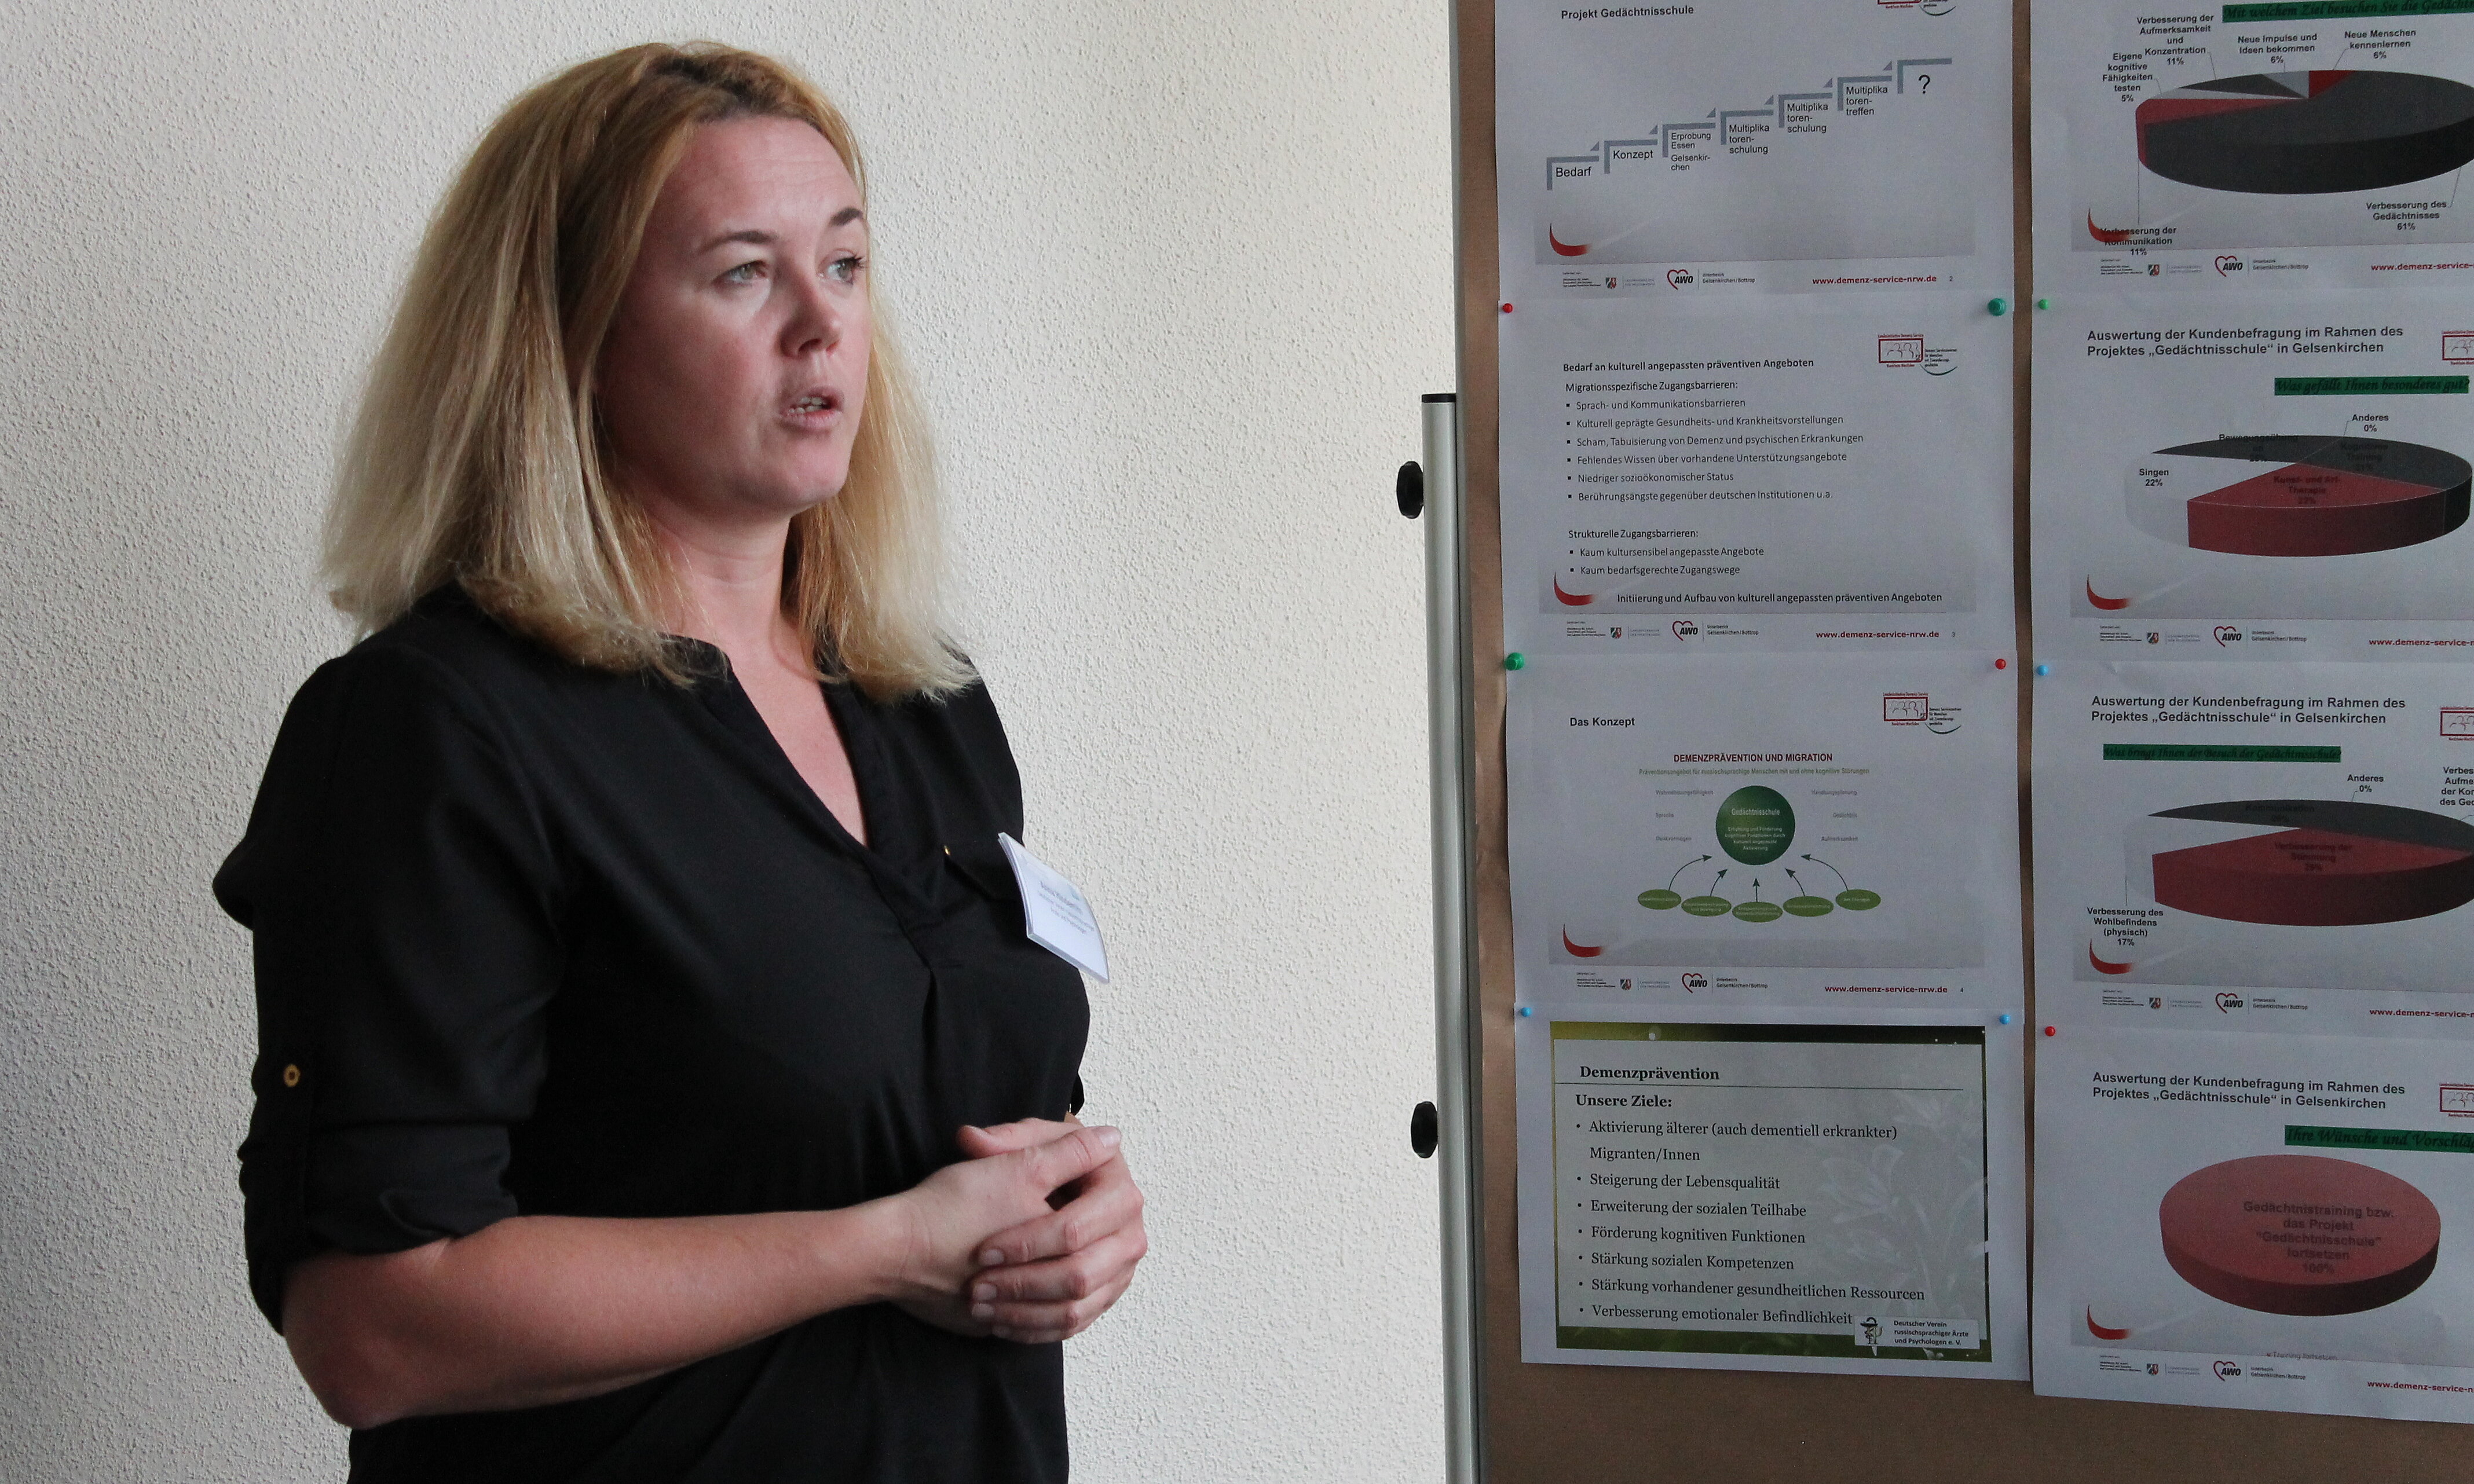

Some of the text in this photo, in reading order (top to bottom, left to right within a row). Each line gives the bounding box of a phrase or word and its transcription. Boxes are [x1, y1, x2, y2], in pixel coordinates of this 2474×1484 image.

[1562, 5, 1693, 21] Projekt Gedächtnisschule
[2140, 25, 2211, 35] Aufmerksamkeit
[2263, 35, 2297, 43] Impulse
[2350, 41, 2410, 49] kennenlernen
[2145, 47, 2205, 55] Konzentration
[2113, 53, 2142, 61] Eigene
[2108, 63, 2147, 72] kognitive
[2103, 74, 2153, 83] Fähigkeiten
[1919, 75, 1930, 94] ?
[1846, 86, 1887, 96] Multiplika
[1787, 103, 1828, 112] Multiplika
[1846, 107, 1874, 115] treffen
[1729, 124, 1769, 134] Multiplika
[1788, 124, 1827, 134] schulung
[1671, 132, 1711, 141] Erprobung
[1613, 150, 1653, 160] Konzept
[1730, 145, 1767, 155] schulung
[1556, 166, 1591, 177] Bedarf
[2373, 212, 2439, 220] Gedächtnisses
[2398, 222, 2415, 230] 61%
[2223, 262, 2243, 270] AWO
[1813, 276, 1937, 284] www.demenz-service-nrw.de
[2088, 326, 2403, 342] Auswertung der Kundenbefragung im Rahmen des
[2088, 346, 2144, 358] Projektes
[2278, 343, 2288, 353] in
[2293, 342, 2383, 353] Gelsenkirchen
[1564, 363, 1593, 371] Bedarf
[1609, 362, 1645, 371] kulturell
[1648, 362, 1704, 371] angepassten
[1707, 360, 1761, 370] präventiven
[1763, 358, 1813, 369] Angeboten
[1566, 381, 1737, 393] Migrationsspezifische Zugangsbarrieren:
[1577, 398, 1745, 411] Sprach- und Kommunikationsbarrieren
[1578, 456, 1622, 464] Fehlendes
[1659, 455, 1678, 463] über
[1681, 454, 1734, 463] vorhandene
[1737, 452, 1846, 463] Unterstützungsangebote
[2139, 468, 2169, 477] Singen
[1569, 529, 1698, 539] Strukturelle Zugangsbarrieren:
[1608, 566, 1678, 576] bedarfsgerechte
[1681, 566, 1740, 576] Zugangswege
[1618, 595, 1663, 604] Initiierung
[1665, 594, 1681, 602] und
[1685, 593, 1716, 602] Aufbau
[1738, 593, 1774, 602] kulturell
[1777, 595, 1833, 603] angepassten
[1836, 593, 1889, 603] präventiven
[1891, 593, 1942, 603] Angeboten
[1571, 717, 1634, 727] Das Konzept
[1674, 753, 1762, 762] DEMENZPRÄVENTION
[2087, 907, 2146, 917] Verbesserung
[2094, 918, 2157, 926] Wohlbefindens
[2104, 928, 2147, 937] (physisch)
[1580, 1067, 1719, 1081] Demenzprävention
[2093, 1072, 2405, 1094] Auswertung der Kundenbefragung im Rahmen des
[1576, 1094, 1671, 1107] Unsere Ziele:
[2094, 1087, 2149, 1100] Projektes
[2281, 1095, 2291, 1105] in
[2296, 1095, 2385, 1108] Gelsenkirchen
[1589, 1120, 1897, 1139] Aktivierung älterer (auch dementiell erkrankter)
[2288, 1128, 2407, 1145] Ihre Wünsche und
[1590, 1147, 1700, 1162] Migranten/Innen
[1590, 1174, 1780, 1190] Steigerung der Lebensqualität
[2283, 1219, 2354, 1232] das Projekt
[1592, 1226, 1805, 1243] Förderung kognitiven Funktionen
[1592, 1279, 1924, 1300] Stärkung vorhandener gesundheitlichen Ressourcen
